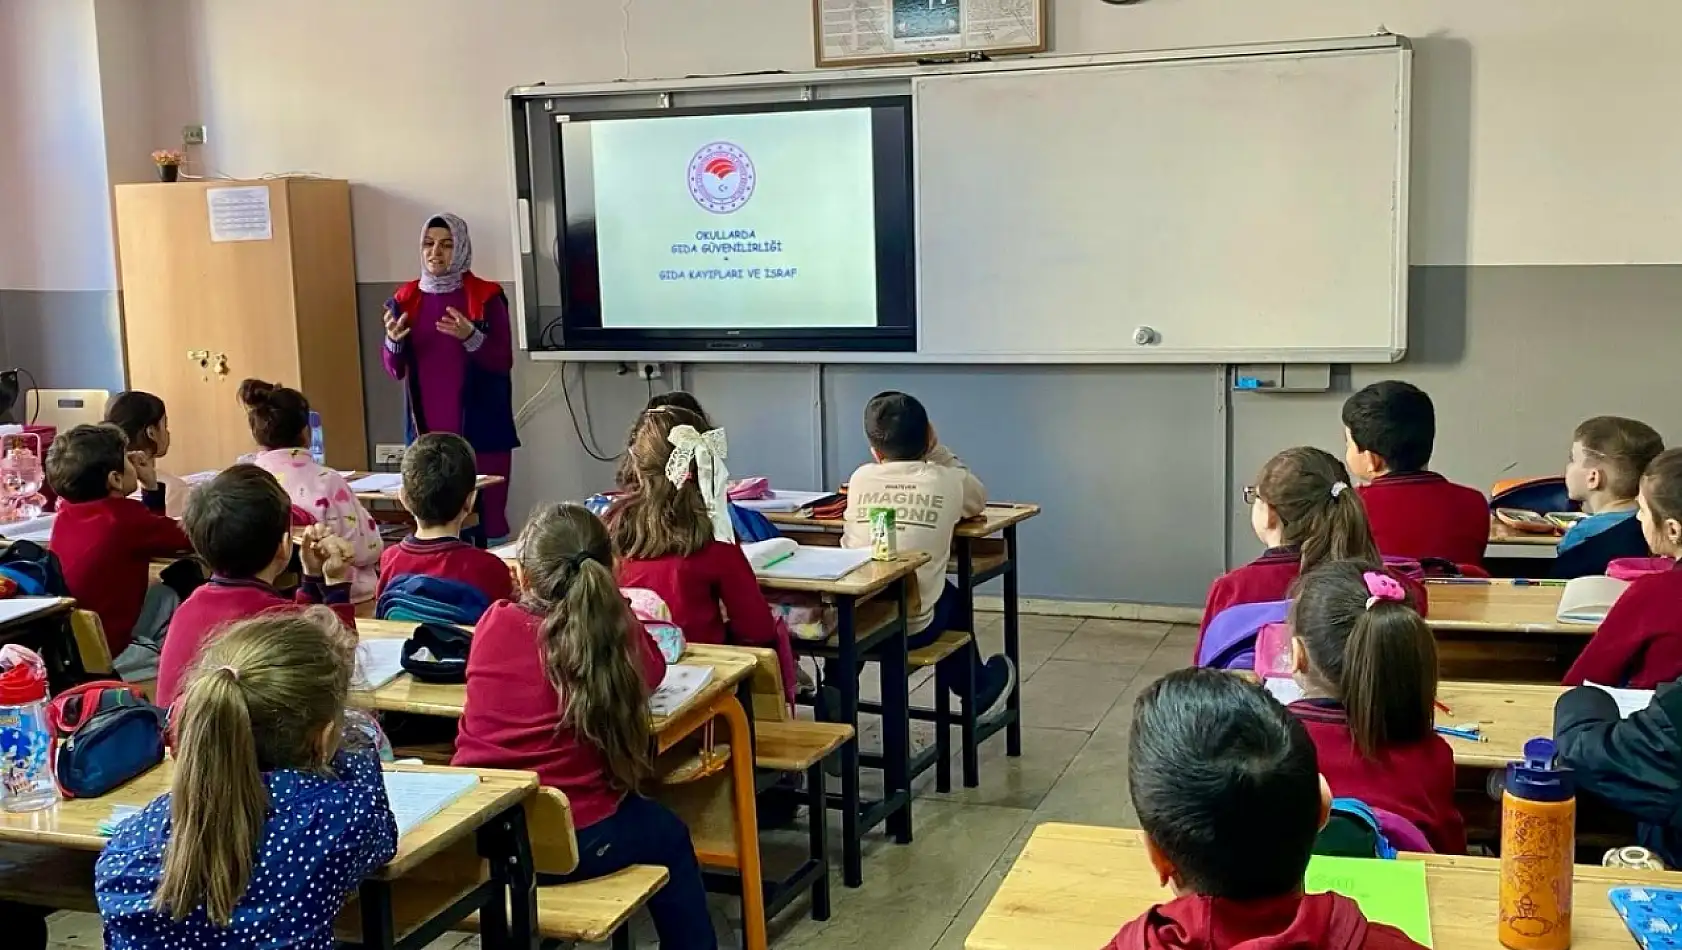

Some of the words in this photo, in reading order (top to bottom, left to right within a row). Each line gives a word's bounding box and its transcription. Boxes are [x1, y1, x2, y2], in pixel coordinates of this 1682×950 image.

[695, 230, 756, 240] OKULLARDA
[671, 243, 698, 253] GIDA
[659, 270, 685, 280] GIDA
[689, 268, 744, 280] KAYIPLARI
[747, 268, 762, 279] VE
[857, 492, 944, 508] IMAGINE
[856, 507, 938, 522] BOND
